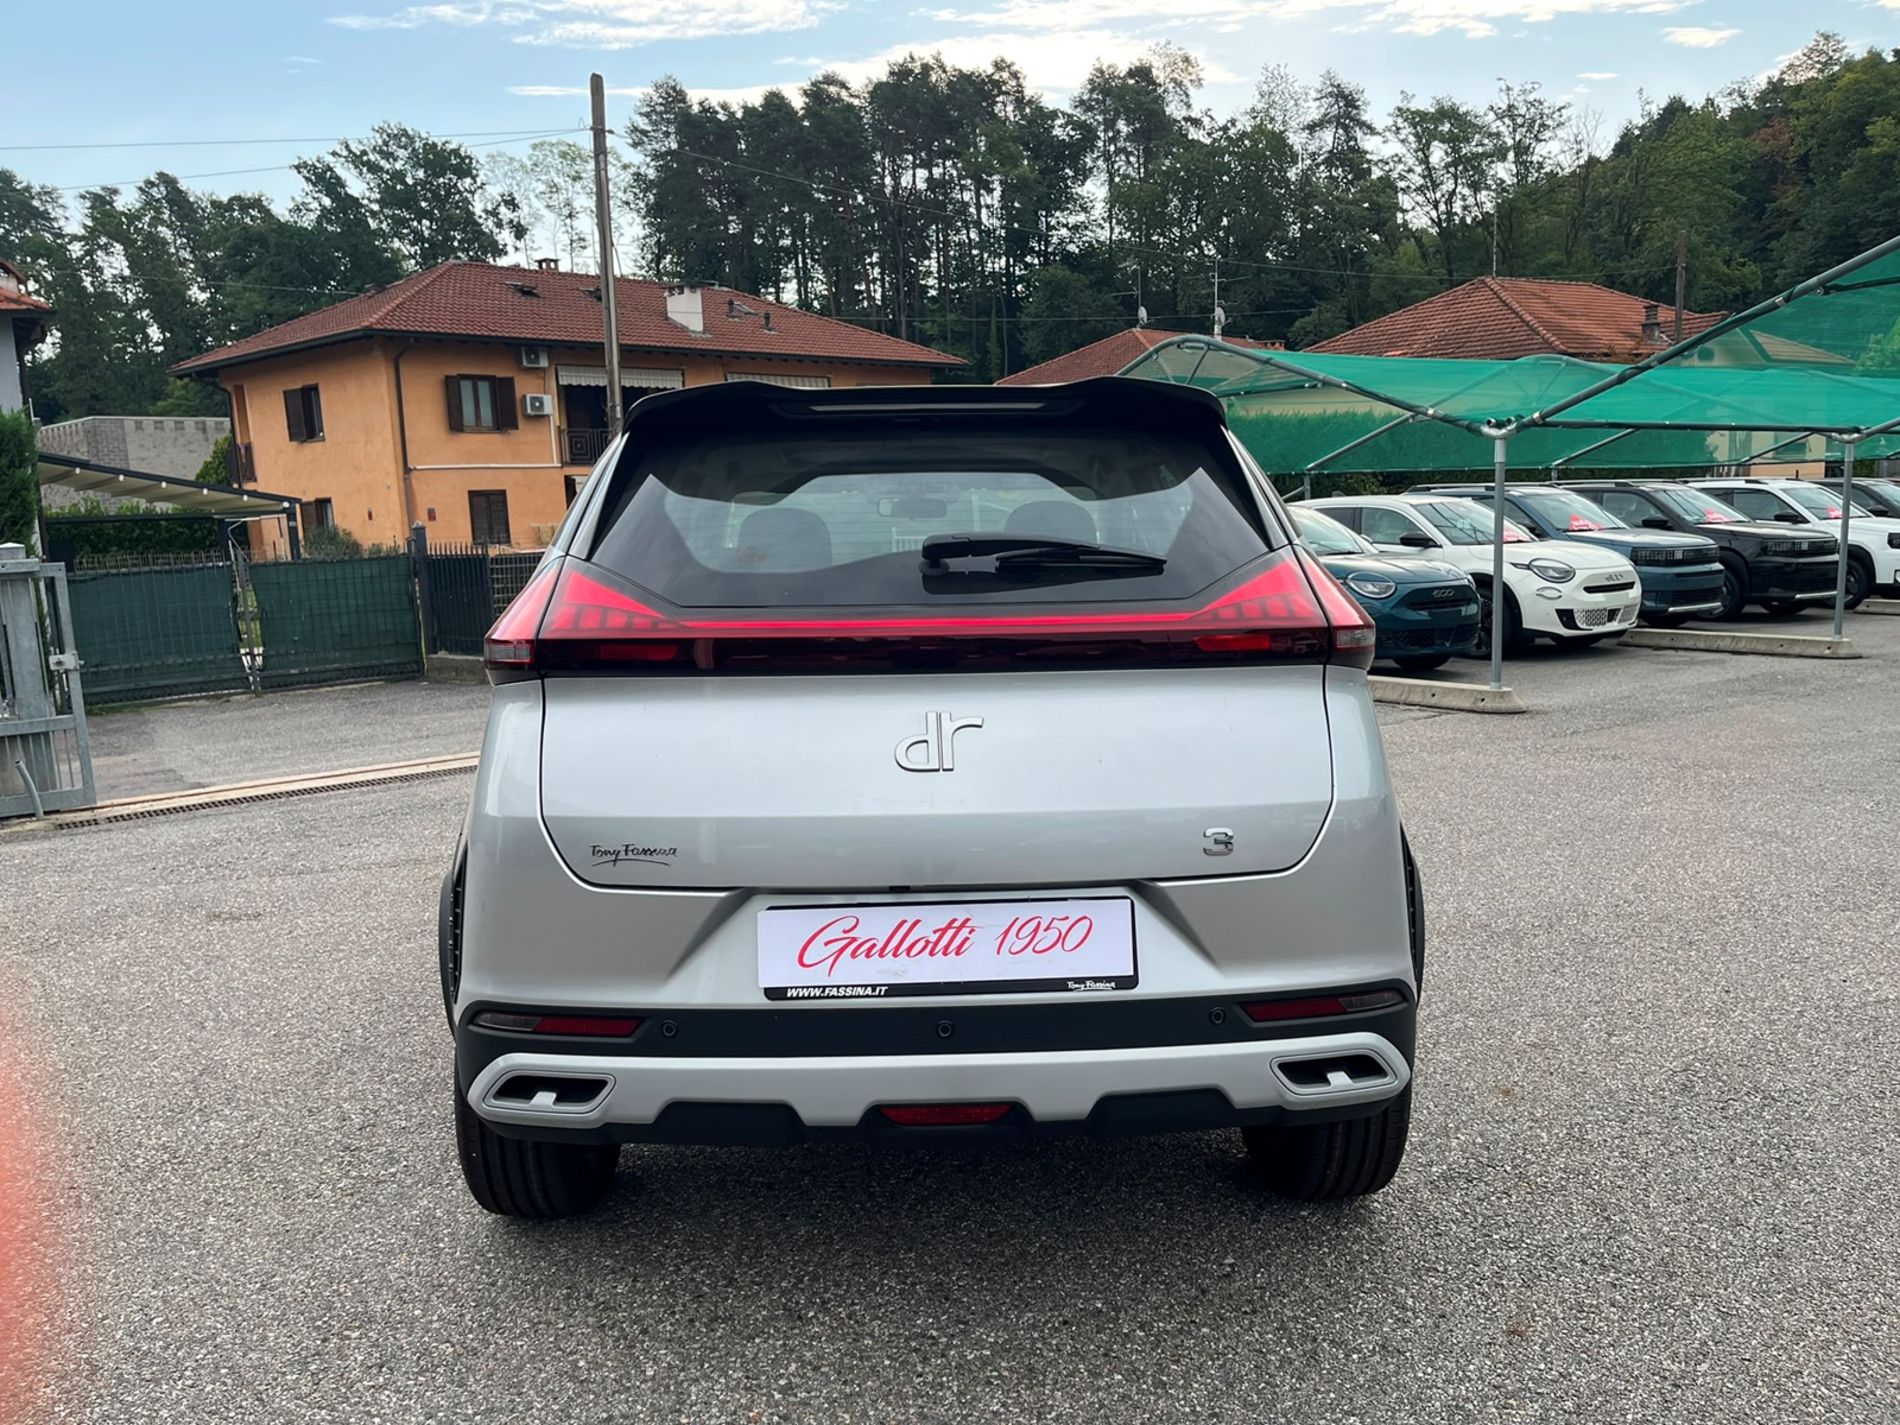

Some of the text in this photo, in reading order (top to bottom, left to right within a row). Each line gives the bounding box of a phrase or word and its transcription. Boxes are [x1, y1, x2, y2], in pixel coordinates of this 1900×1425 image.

[1203, 827, 1234, 856] 3
[590, 844, 621, 867] Tony
[797, 914, 1094, 977] Gallotti 1950
[786, 986, 889, 998] WWW.FASSINA.IT
